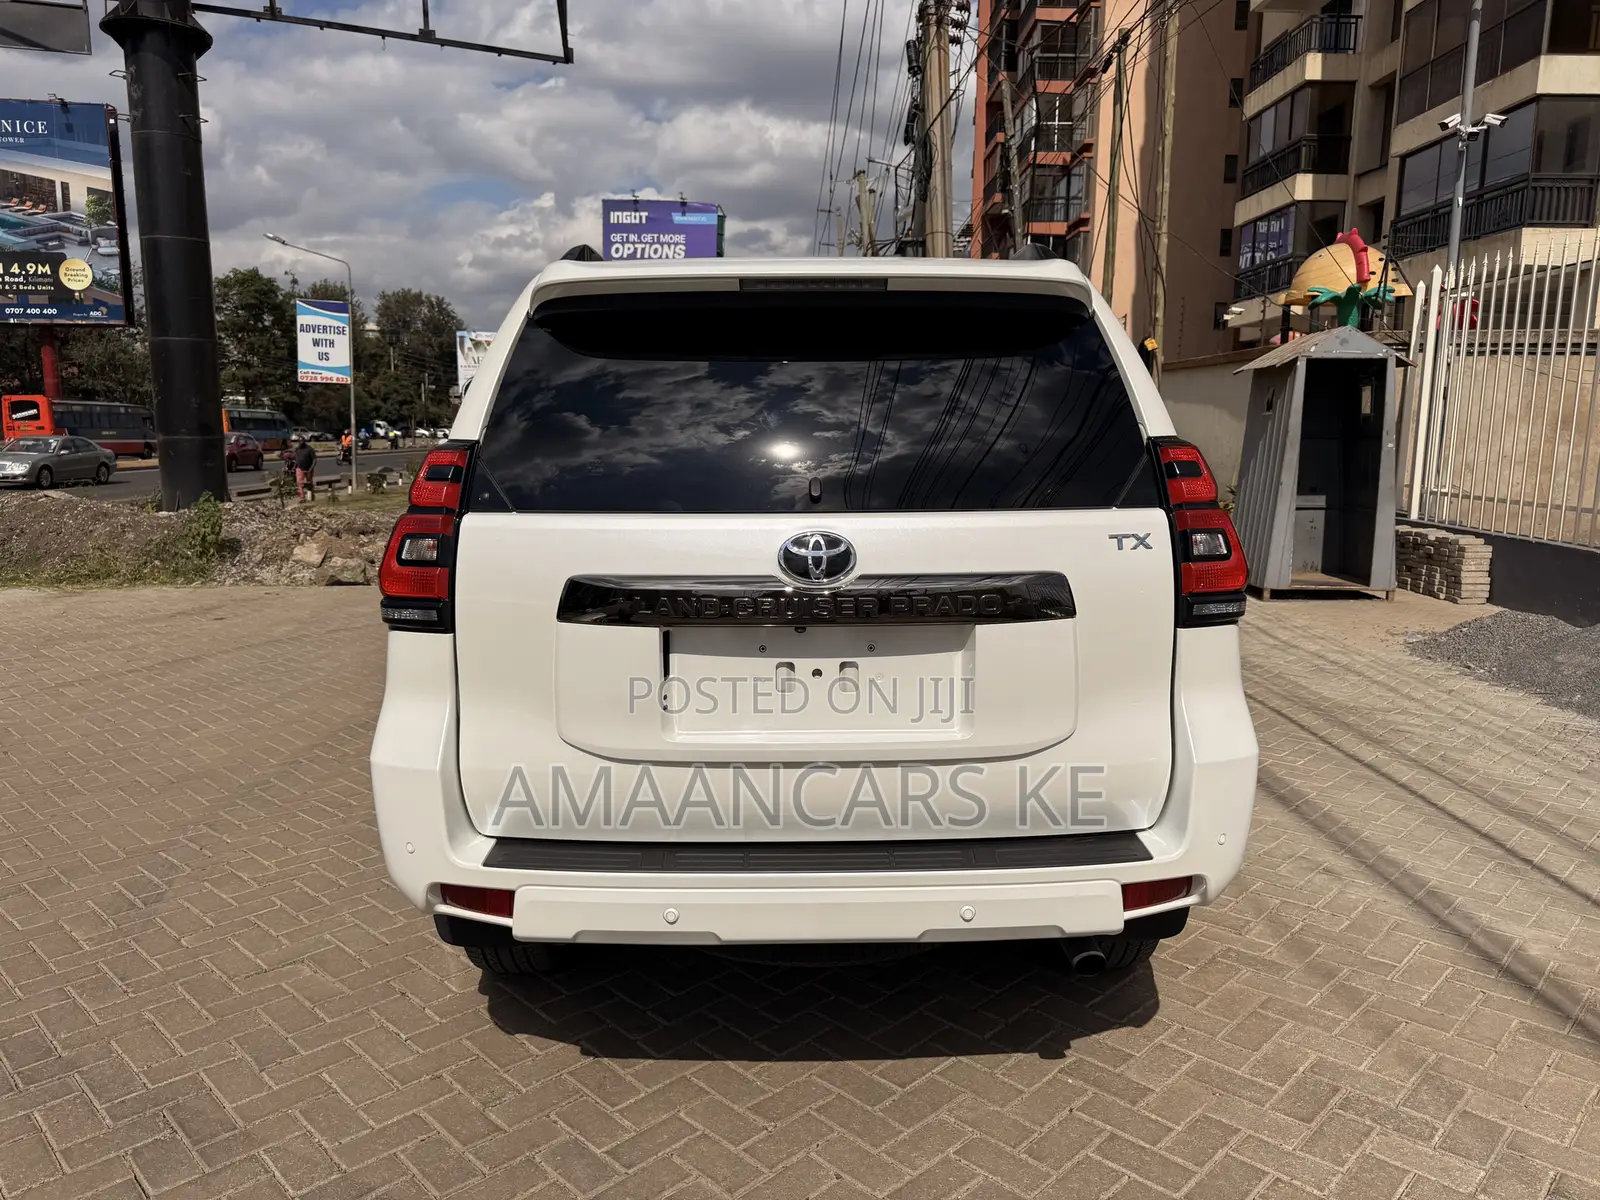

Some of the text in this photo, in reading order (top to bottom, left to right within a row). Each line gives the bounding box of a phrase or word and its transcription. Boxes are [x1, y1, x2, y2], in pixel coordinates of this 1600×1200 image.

[610, 211, 649, 224] INGOT
[610, 233, 686, 243] GET IN. GET MORE
[610, 243, 687, 259] OPTIONS
[10, 262, 51, 275] 4.9M
[4, 275, 27, 283] Road,
[5, 307, 24, 315] 0707
[299, 323, 347, 335] ADVERTISE
[312, 338, 335, 348] WITH
[318, 351, 330, 361] US
[1108, 532, 1153, 551] TX
[634, 594, 1002, 621] LAND CRUISER PRADO
